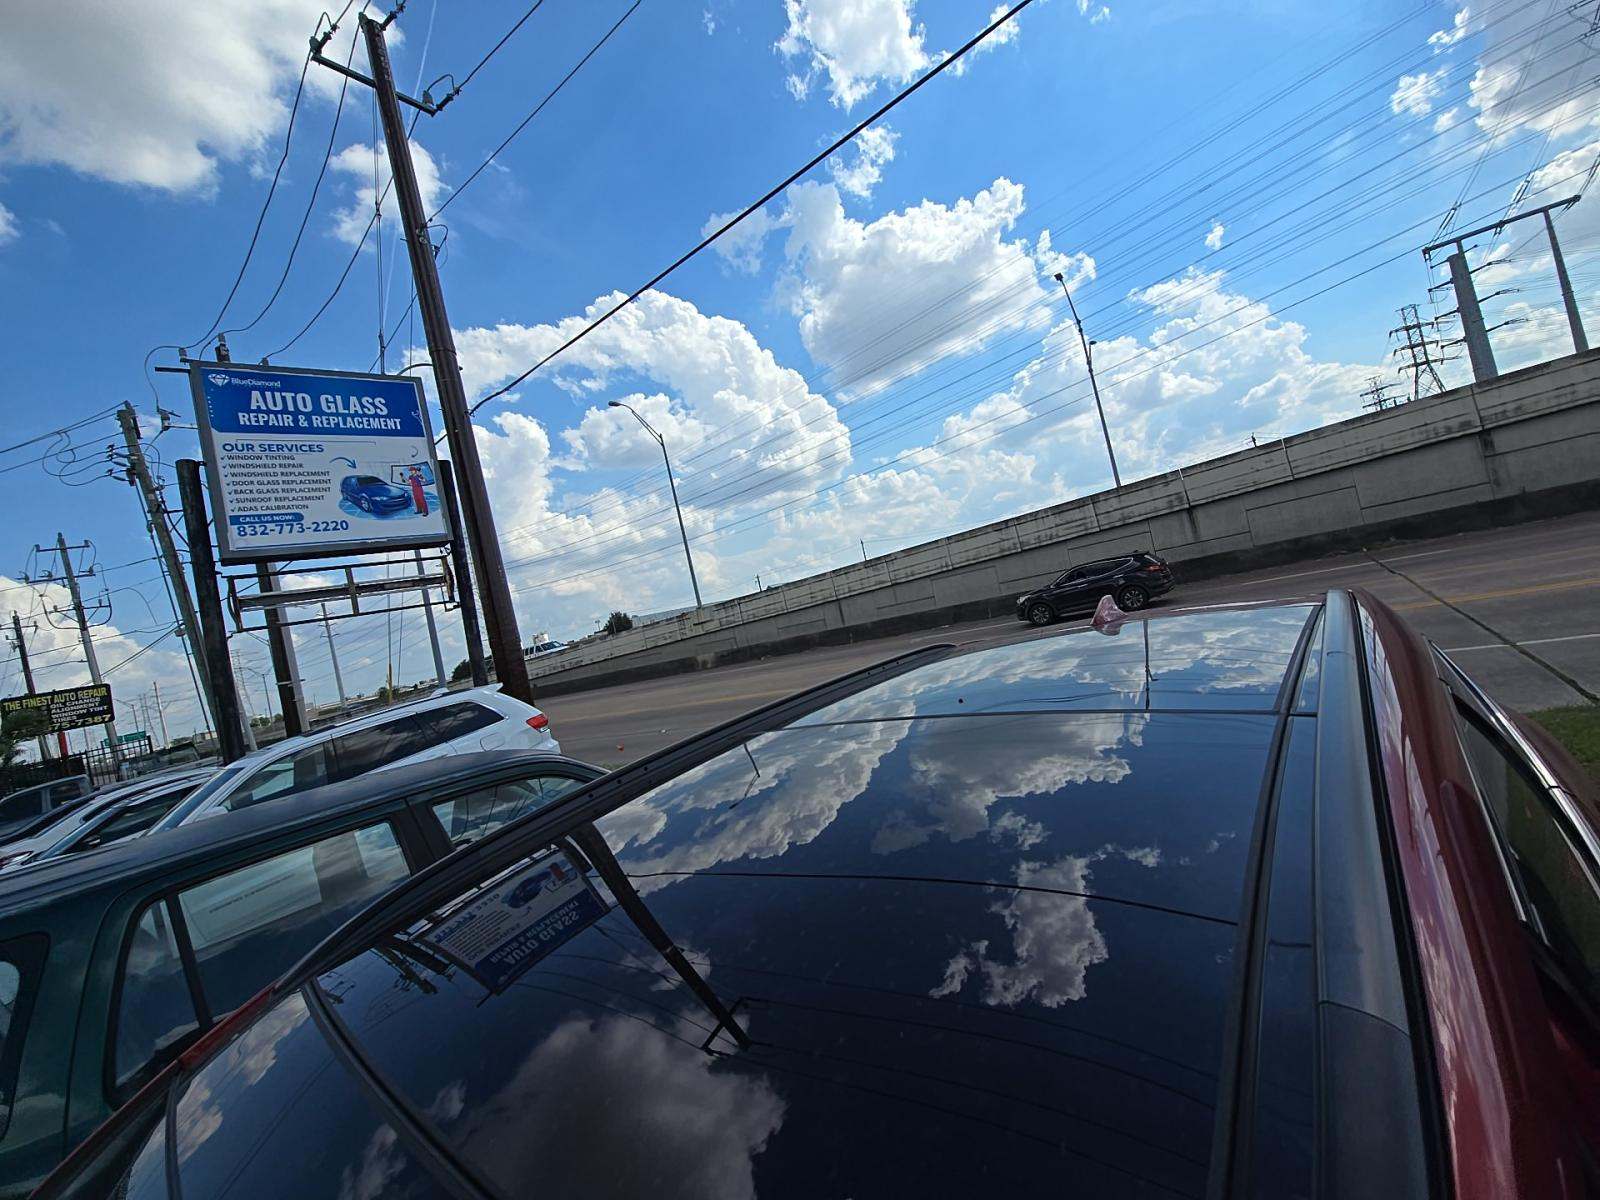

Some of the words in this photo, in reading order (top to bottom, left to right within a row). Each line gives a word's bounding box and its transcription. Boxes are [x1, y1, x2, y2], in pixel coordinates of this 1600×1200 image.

[231, 377, 281, 387] BlueDiamond
[250, 390, 313, 412] AUTO
[321, 394, 389, 415] GLASS
[238, 412, 294, 427] REPAIR
[298, 415, 309, 427] &
[312, 415, 401, 430] REPLACEMENT
[222, 443, 255, 453] OUR
[258, 443, 325, 453] SERVICES
[236, 520, 349, 537] 832-773-2220
[3, 701, 22, 711] THE
[22, 695, 52, 709] FINEST
[54, 692, 76, 703] AUTO
[78, 686, 107, 699] REPAIR
[51, 701, 100, 714] ALIGNMENT
[51, 709, 88, 719] WINDOW
